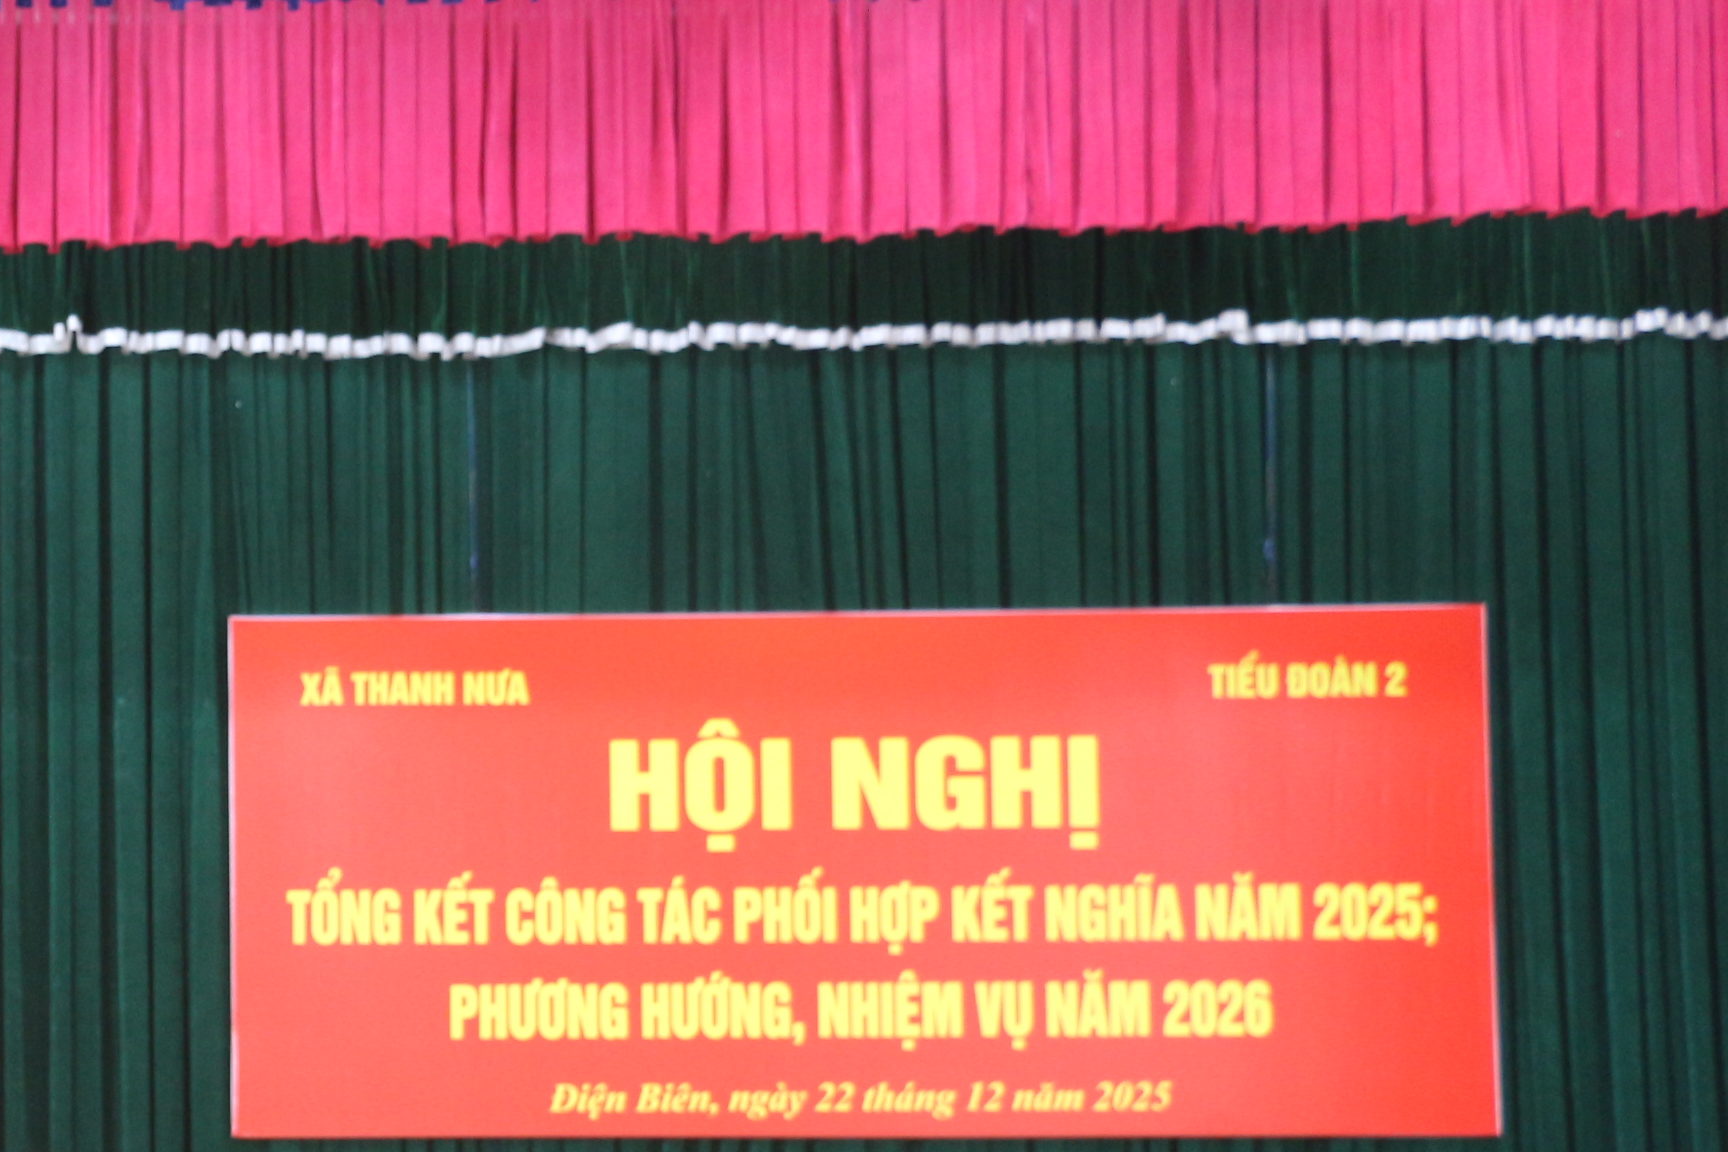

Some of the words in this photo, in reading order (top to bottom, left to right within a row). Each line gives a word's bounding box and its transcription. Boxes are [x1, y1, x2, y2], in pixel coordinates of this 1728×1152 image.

[300, 666, 344, 706] XÃ
[351, 671, 455, 706] THANH
[463, 668, 530, 706] NƯA
[1208, 650, 1279, 699] TIỂU
[1286, 654, 1377, 699] ĐOÀN
[1385, 662, 1408, 698] 2
[609, 718, 792, 854] HỘI
[831, 734, 1101, 850] NGHỊ
[286, 867, 402, 945] TỔNG
[414, 871, 495, 945] KẾT
[505, 876, 626, 945] CÔNG
[636, 876, 721, 944] TÁC
[733, 866, 838, 943] PHỐI
[849, 880, 940, 955] HỢP
[951, 867, 1034, 942] KẾT
[1045, 873, 1184, 942] NGHĨA
[1195, 872, 1302, 940] NĂM
[1313, 882, 1438, 946] 2025;
[449, 977, 630, 1040] PHƯƠNG
[641, 971, 806, 1046] HƯỚNG,
[817, 970, 964, 1050] NHIỆM
[975, 980, 1035, 1051] VỤ
[1045, 969, 1151, 1037] NĂM
[1162, 979, 1274, 1037] 2026
[550, 1083, 628, 1120] Điện
[636, 1082, 720, 1116] Biên,
[727, 1082, 808, 1120] ngày
[814, 1081, 856, 1112] 22
[861, 1081, 957, 1119] tháng
[966, 1081, 1006, 1112] 12
[1011, 1082, 1086, 1112] năm
[1092, 1080, 1174, 1112] 2025
